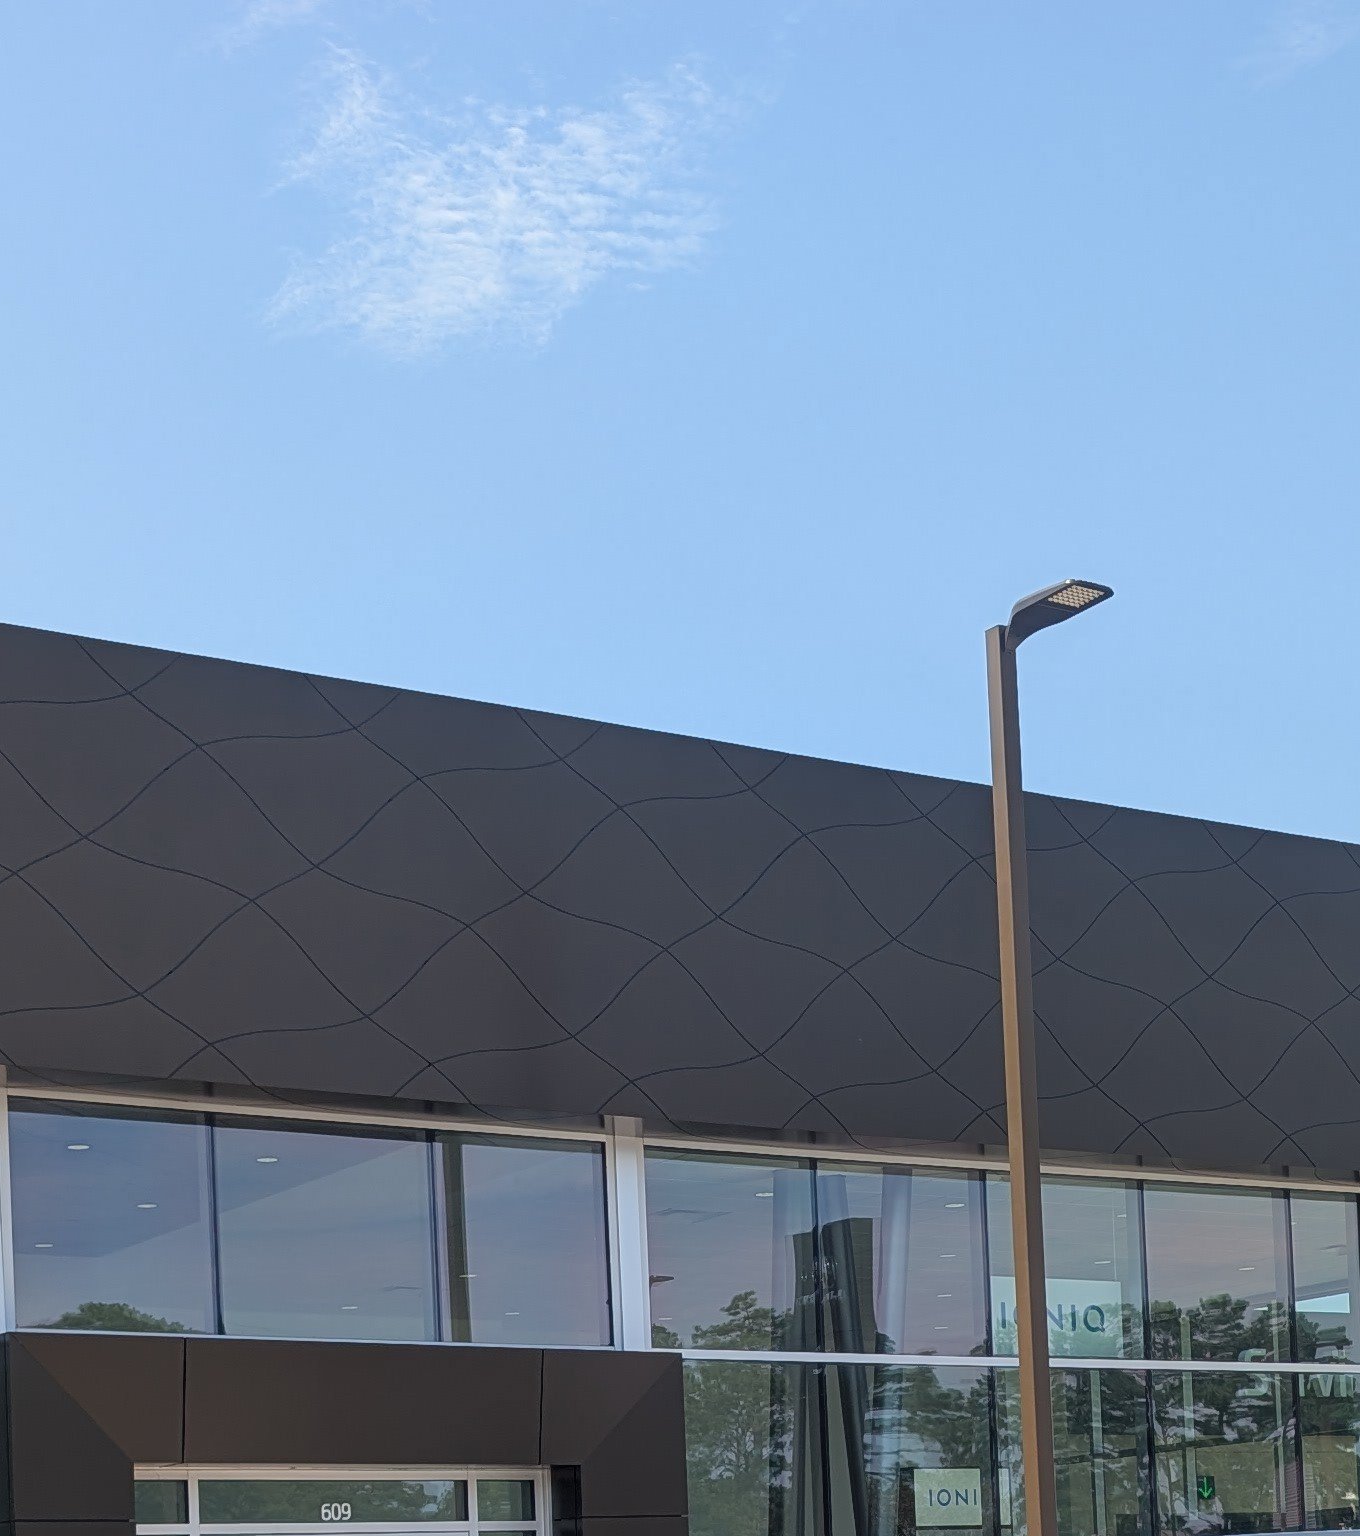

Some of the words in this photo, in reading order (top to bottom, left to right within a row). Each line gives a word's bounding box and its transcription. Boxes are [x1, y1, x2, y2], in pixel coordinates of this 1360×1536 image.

[999, 1302, 1106, 1333] INIQ
[928, 1488, 978, 1507] IONI
[321, 1502, 351, 1521] 609
